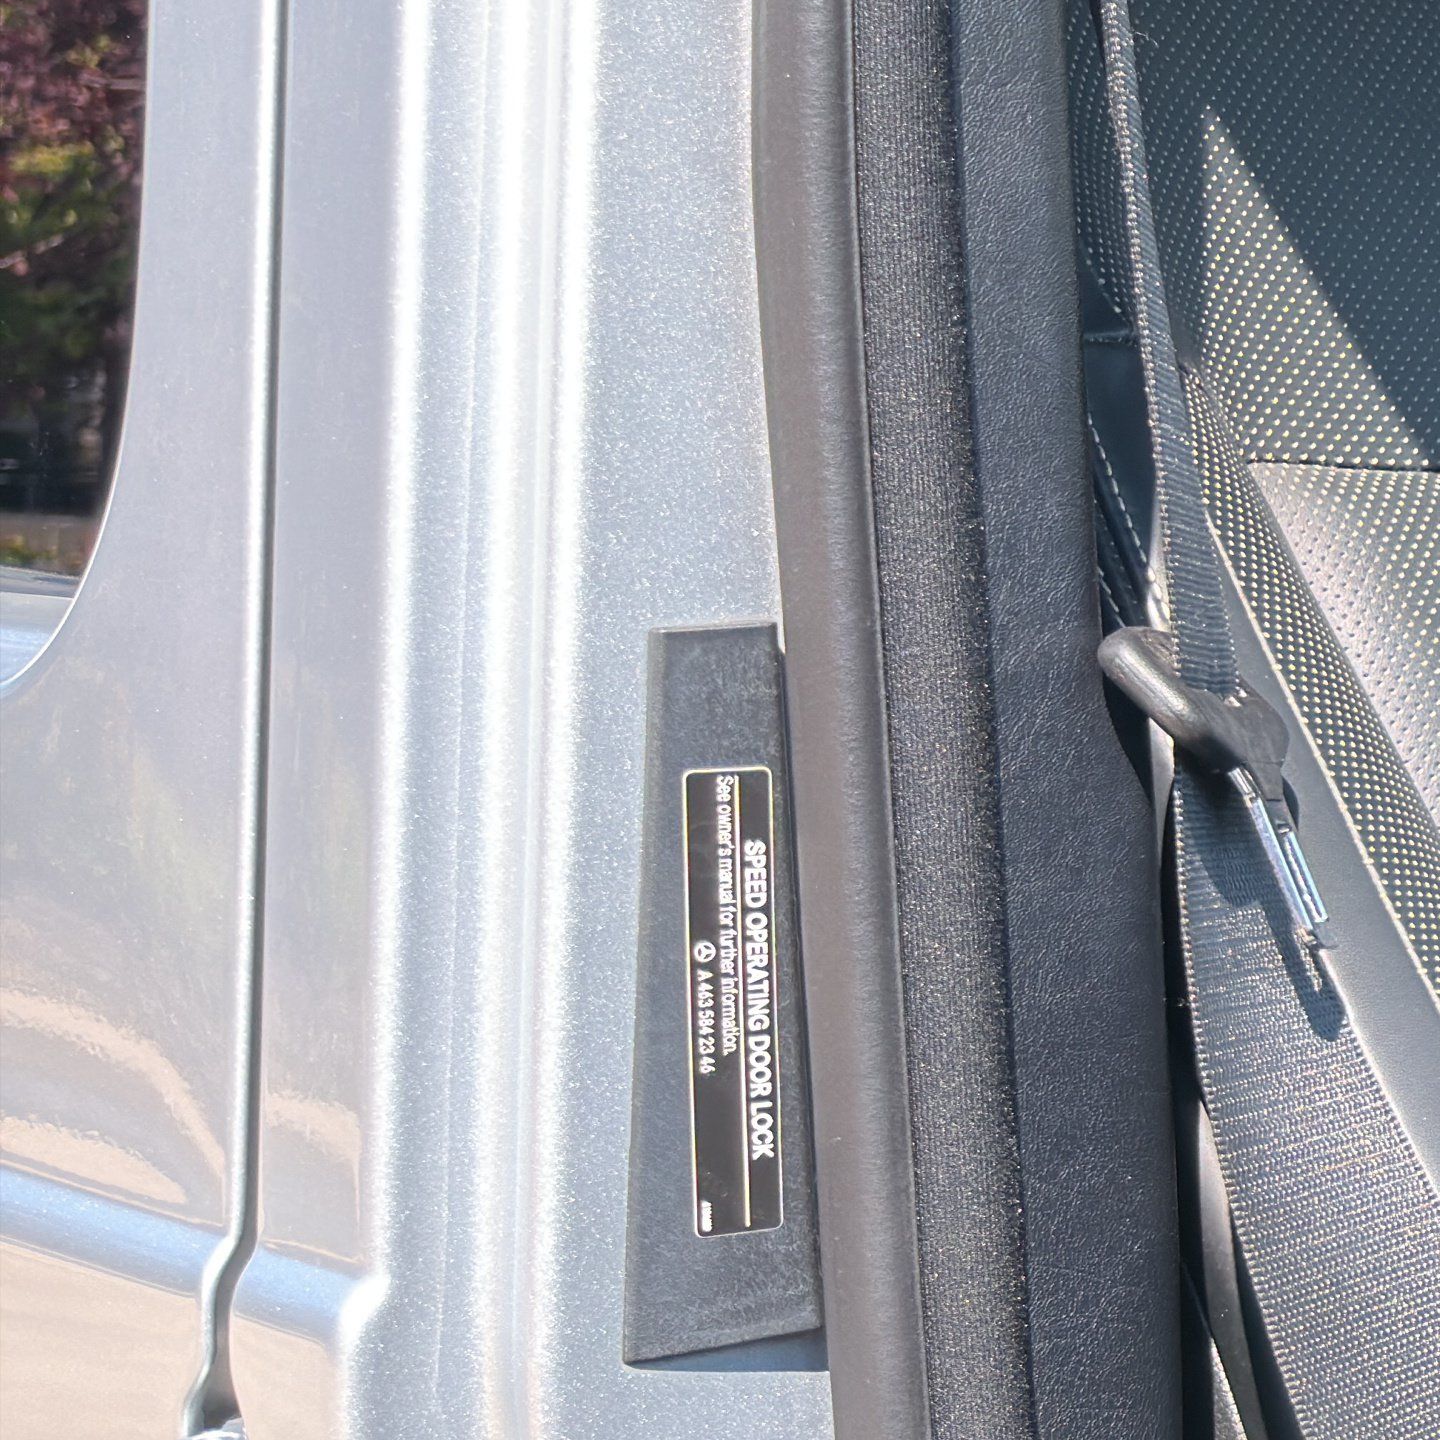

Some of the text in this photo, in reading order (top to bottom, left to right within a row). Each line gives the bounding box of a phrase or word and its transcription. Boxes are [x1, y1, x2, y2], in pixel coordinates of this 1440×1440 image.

[697, 969, 716, 1074] A 463 584 23 46
[717, 774, 740, 1056] See owner's manual for further information.
[743, 839, 775, 1161] SPEED OPERATING DOOR LOCK
